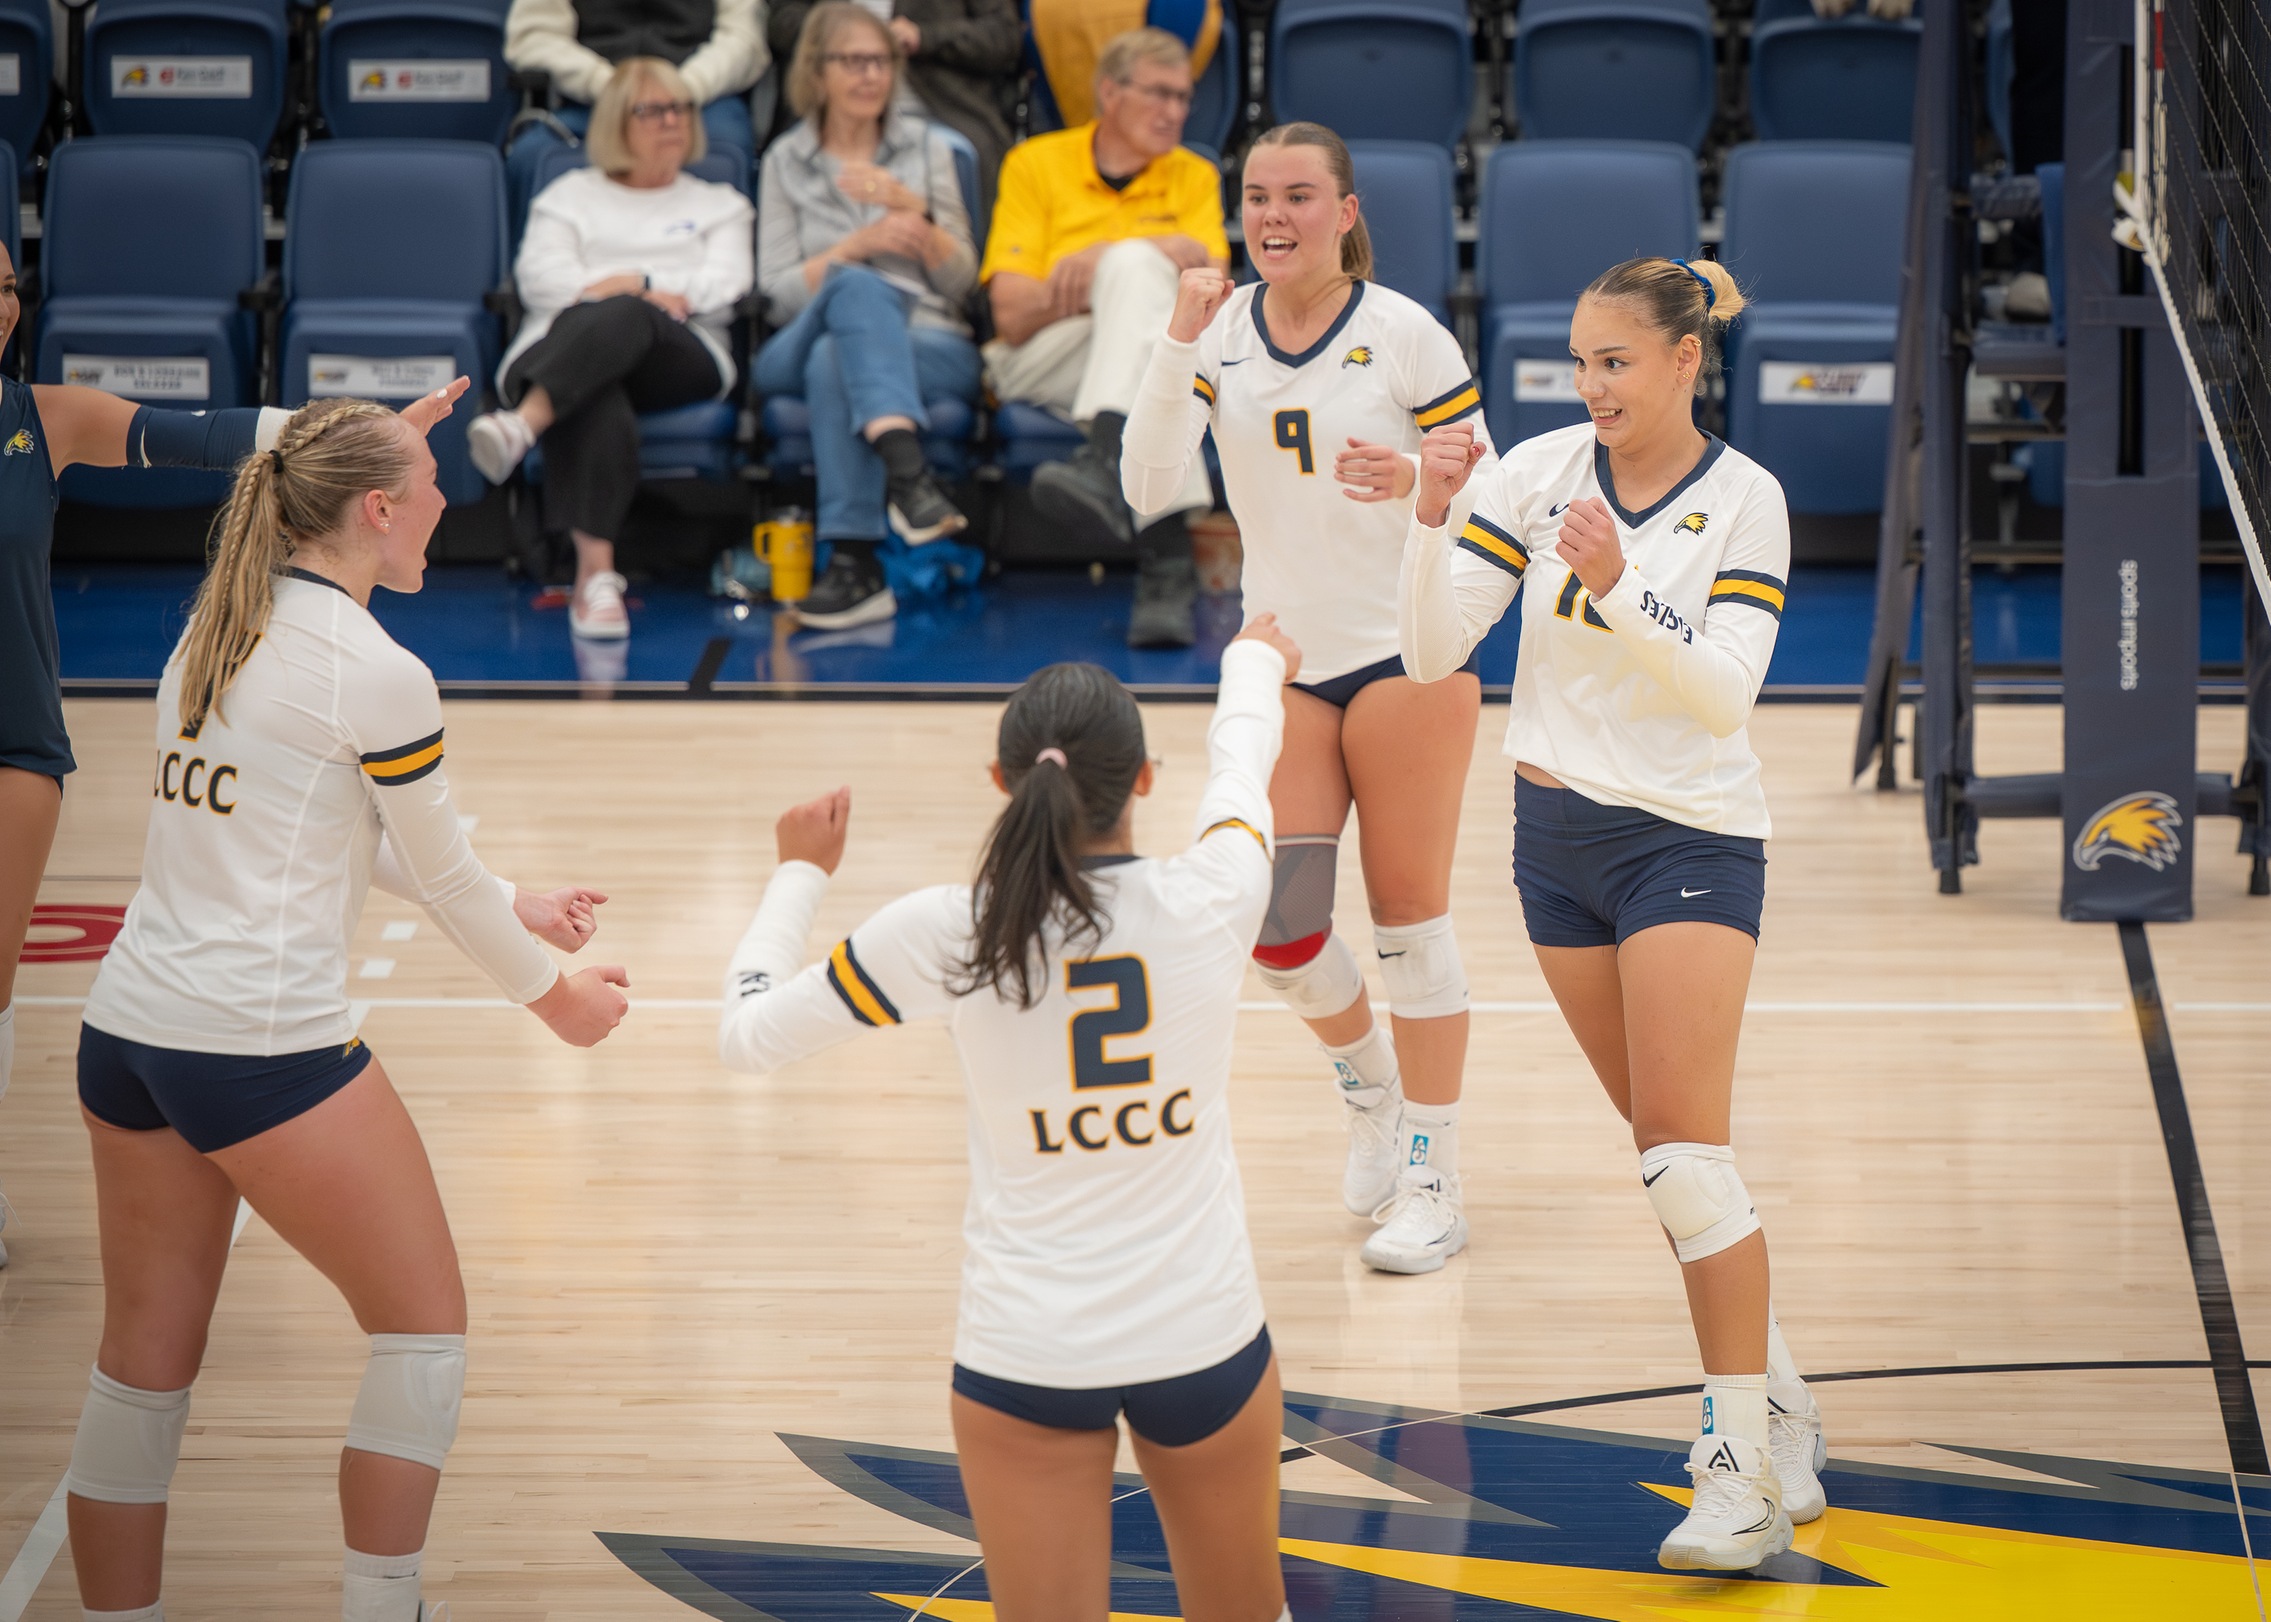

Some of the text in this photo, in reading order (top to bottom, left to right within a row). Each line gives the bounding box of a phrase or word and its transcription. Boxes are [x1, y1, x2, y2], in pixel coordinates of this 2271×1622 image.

[1271, 407, 1317, 476] 9
[1064, 951, 1154, 1093] 2
[1028, 1087, 1195, 1155] LCCC
